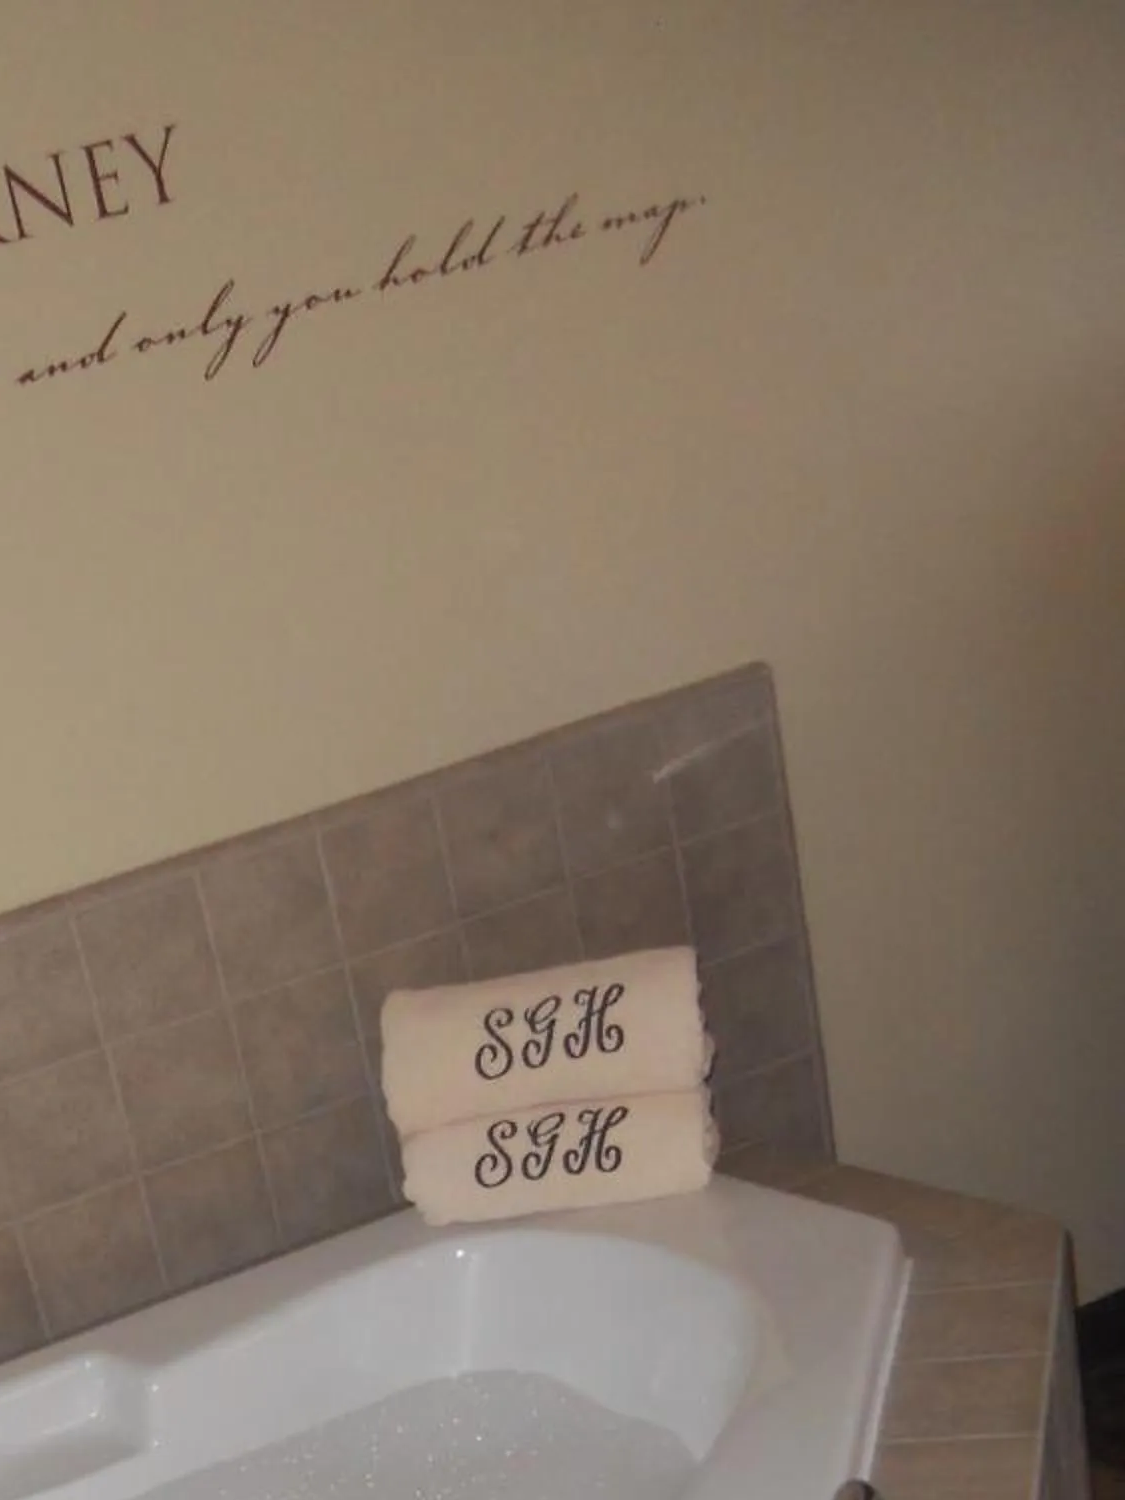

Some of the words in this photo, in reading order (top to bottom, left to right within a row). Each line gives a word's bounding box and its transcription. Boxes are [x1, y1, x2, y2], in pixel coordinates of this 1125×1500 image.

[15, 310, 128, 386] and
[133, 278, 246, 382] only
[251, 287, 362, 369] you
[377, 215, 506, 292] hold
[516, 192, 586, 257] the
[474, 982, 626, 1081] SGH
[474, 1105, 630, 1189] SGH
